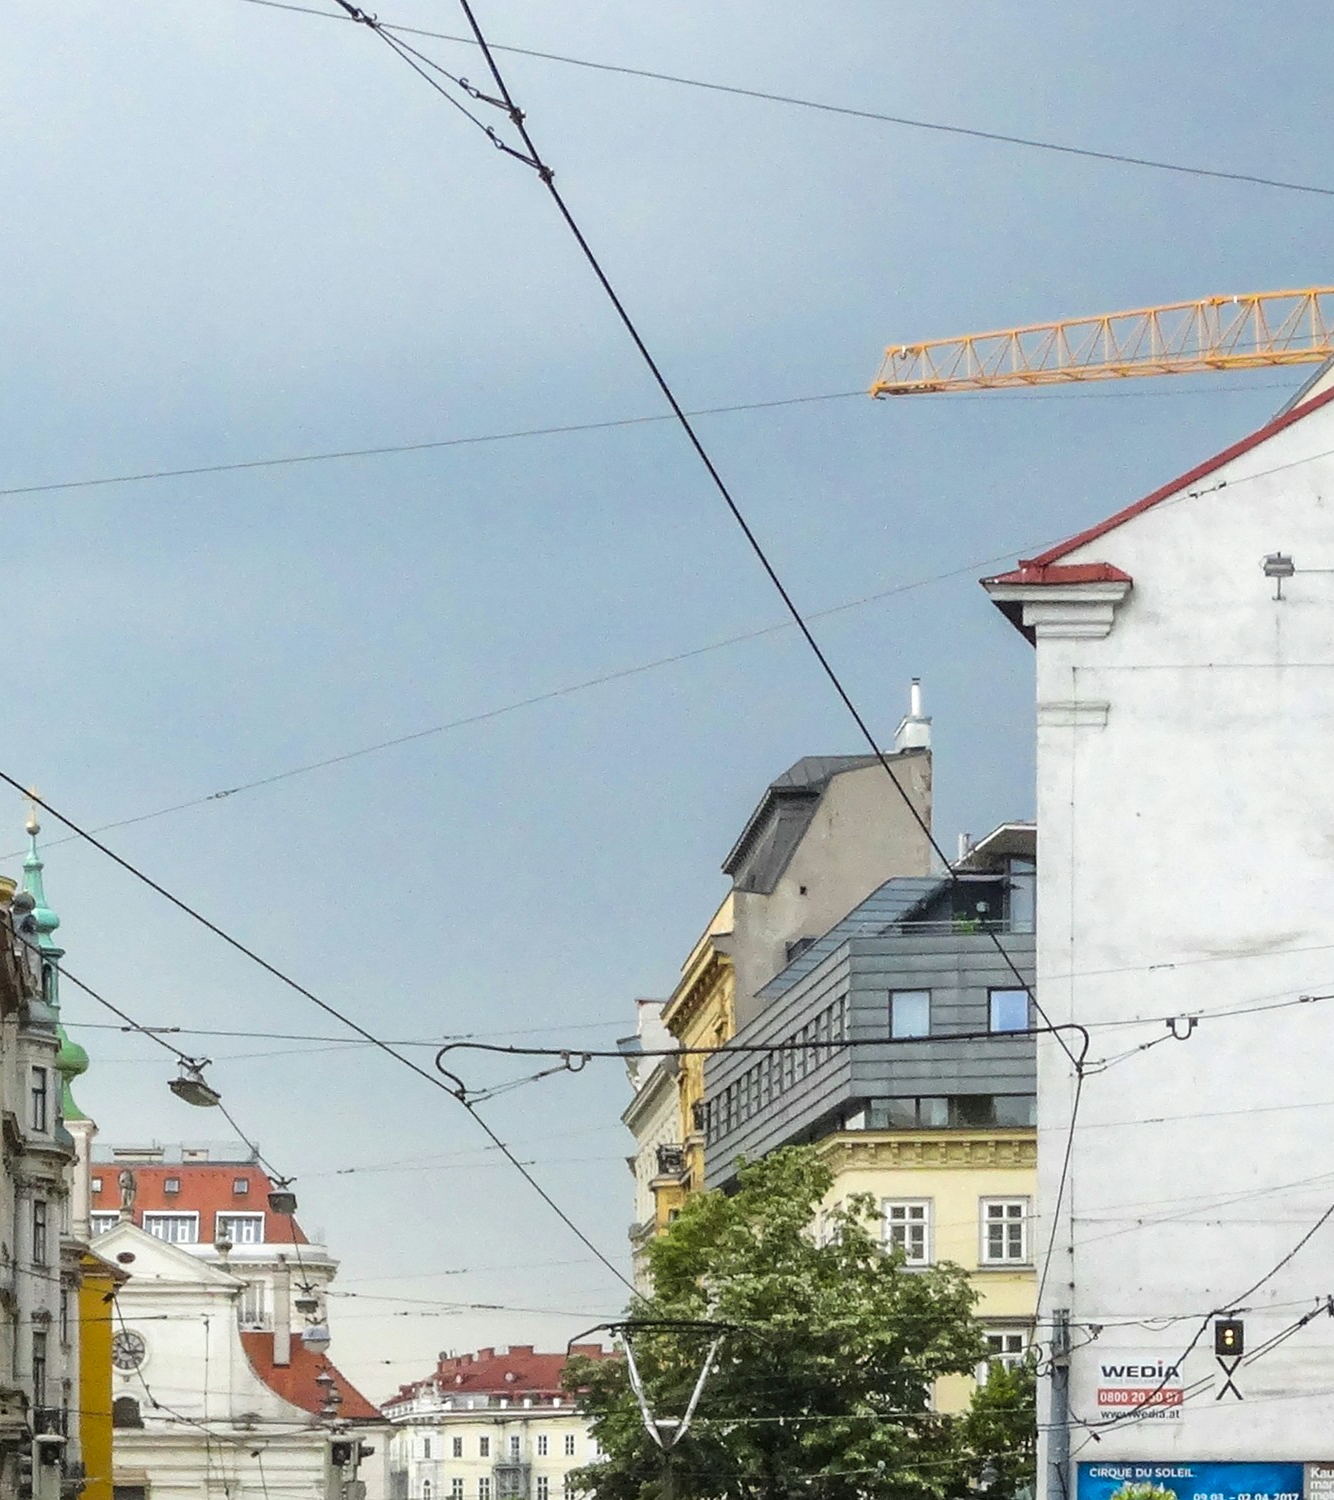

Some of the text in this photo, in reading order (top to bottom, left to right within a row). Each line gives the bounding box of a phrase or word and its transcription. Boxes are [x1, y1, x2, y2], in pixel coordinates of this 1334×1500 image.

[1100, 1392, 1128, 1402] 0800
[1131, 1392, 1145, 1402] 20
[1090, 1468, 1193, 1479] CIRQUE DU SOLEIL
